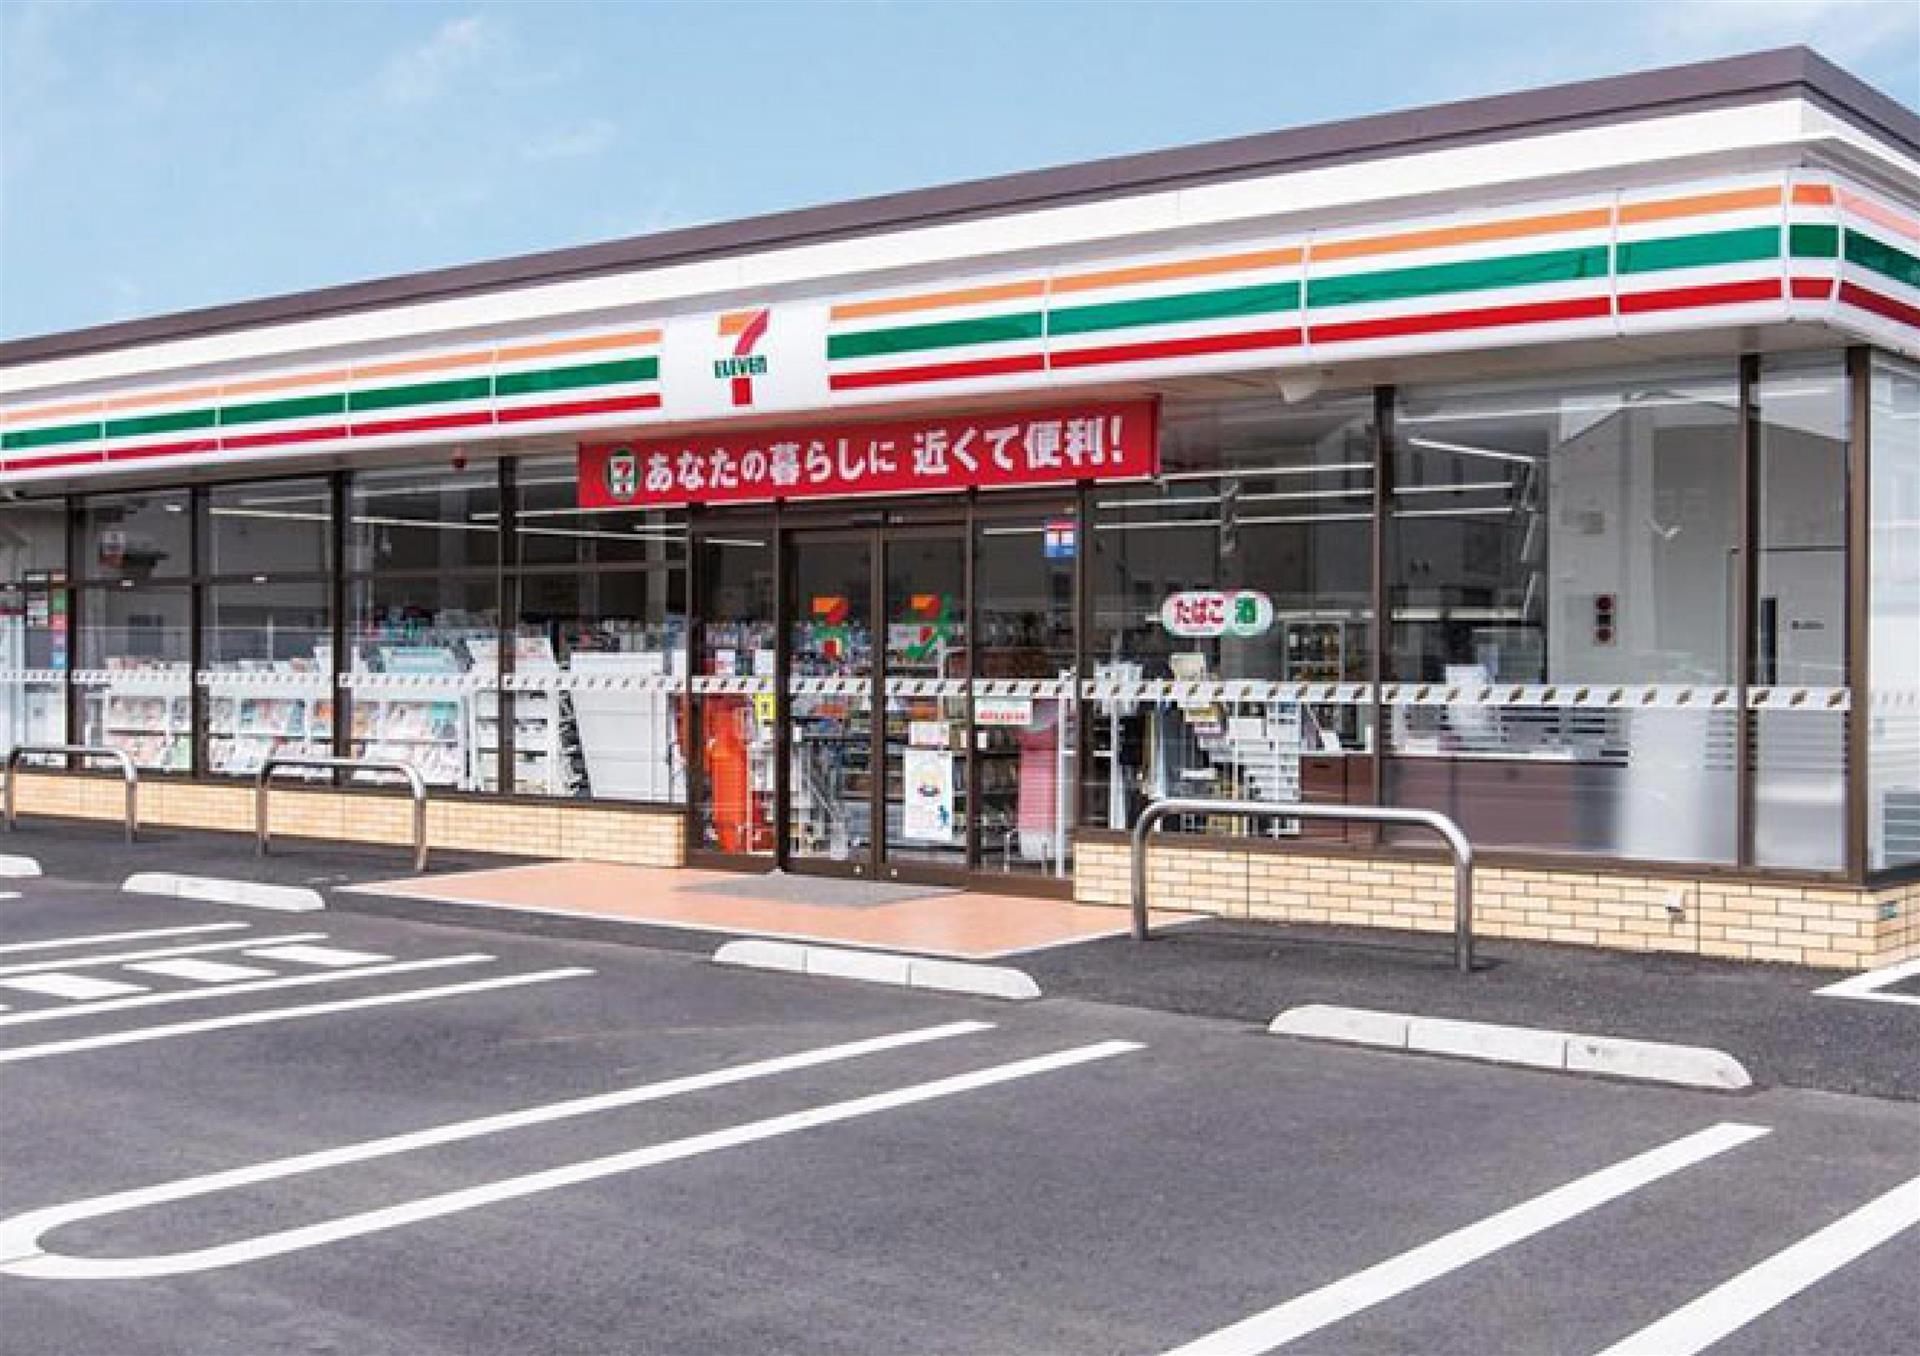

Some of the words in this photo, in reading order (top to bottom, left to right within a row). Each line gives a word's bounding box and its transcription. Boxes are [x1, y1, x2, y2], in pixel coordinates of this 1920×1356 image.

[718, 307, 769, 405] 7
[645, 438, 897, 492] あなたの暮らしに
[1174, 598, 1224, 624] たばこ
